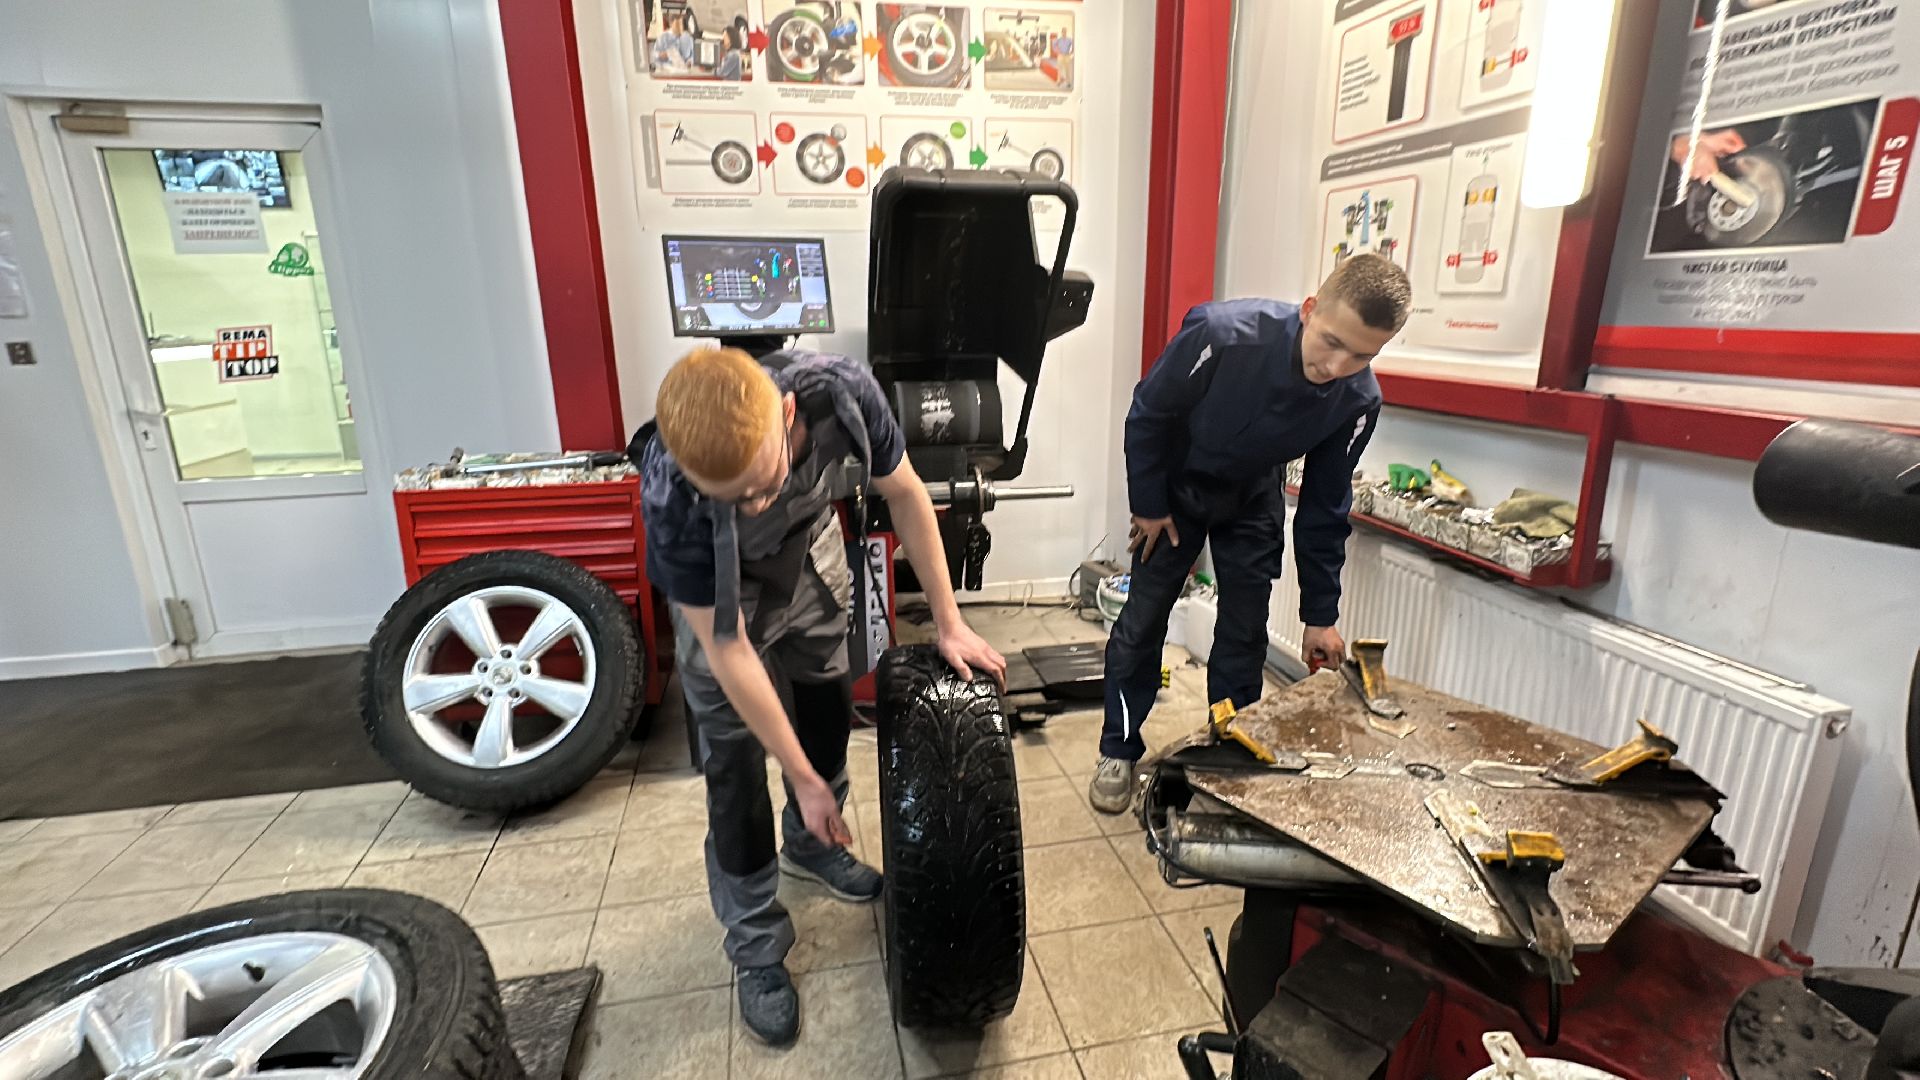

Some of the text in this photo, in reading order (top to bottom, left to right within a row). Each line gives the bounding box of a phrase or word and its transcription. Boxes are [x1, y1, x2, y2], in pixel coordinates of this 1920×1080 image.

[1871, 135, 1909, 200] ШАГ 5
[222, 329, 267, 341] REMA
[213, 340, 266, 359] TIP
[226, 357, 278, 377] TOP
